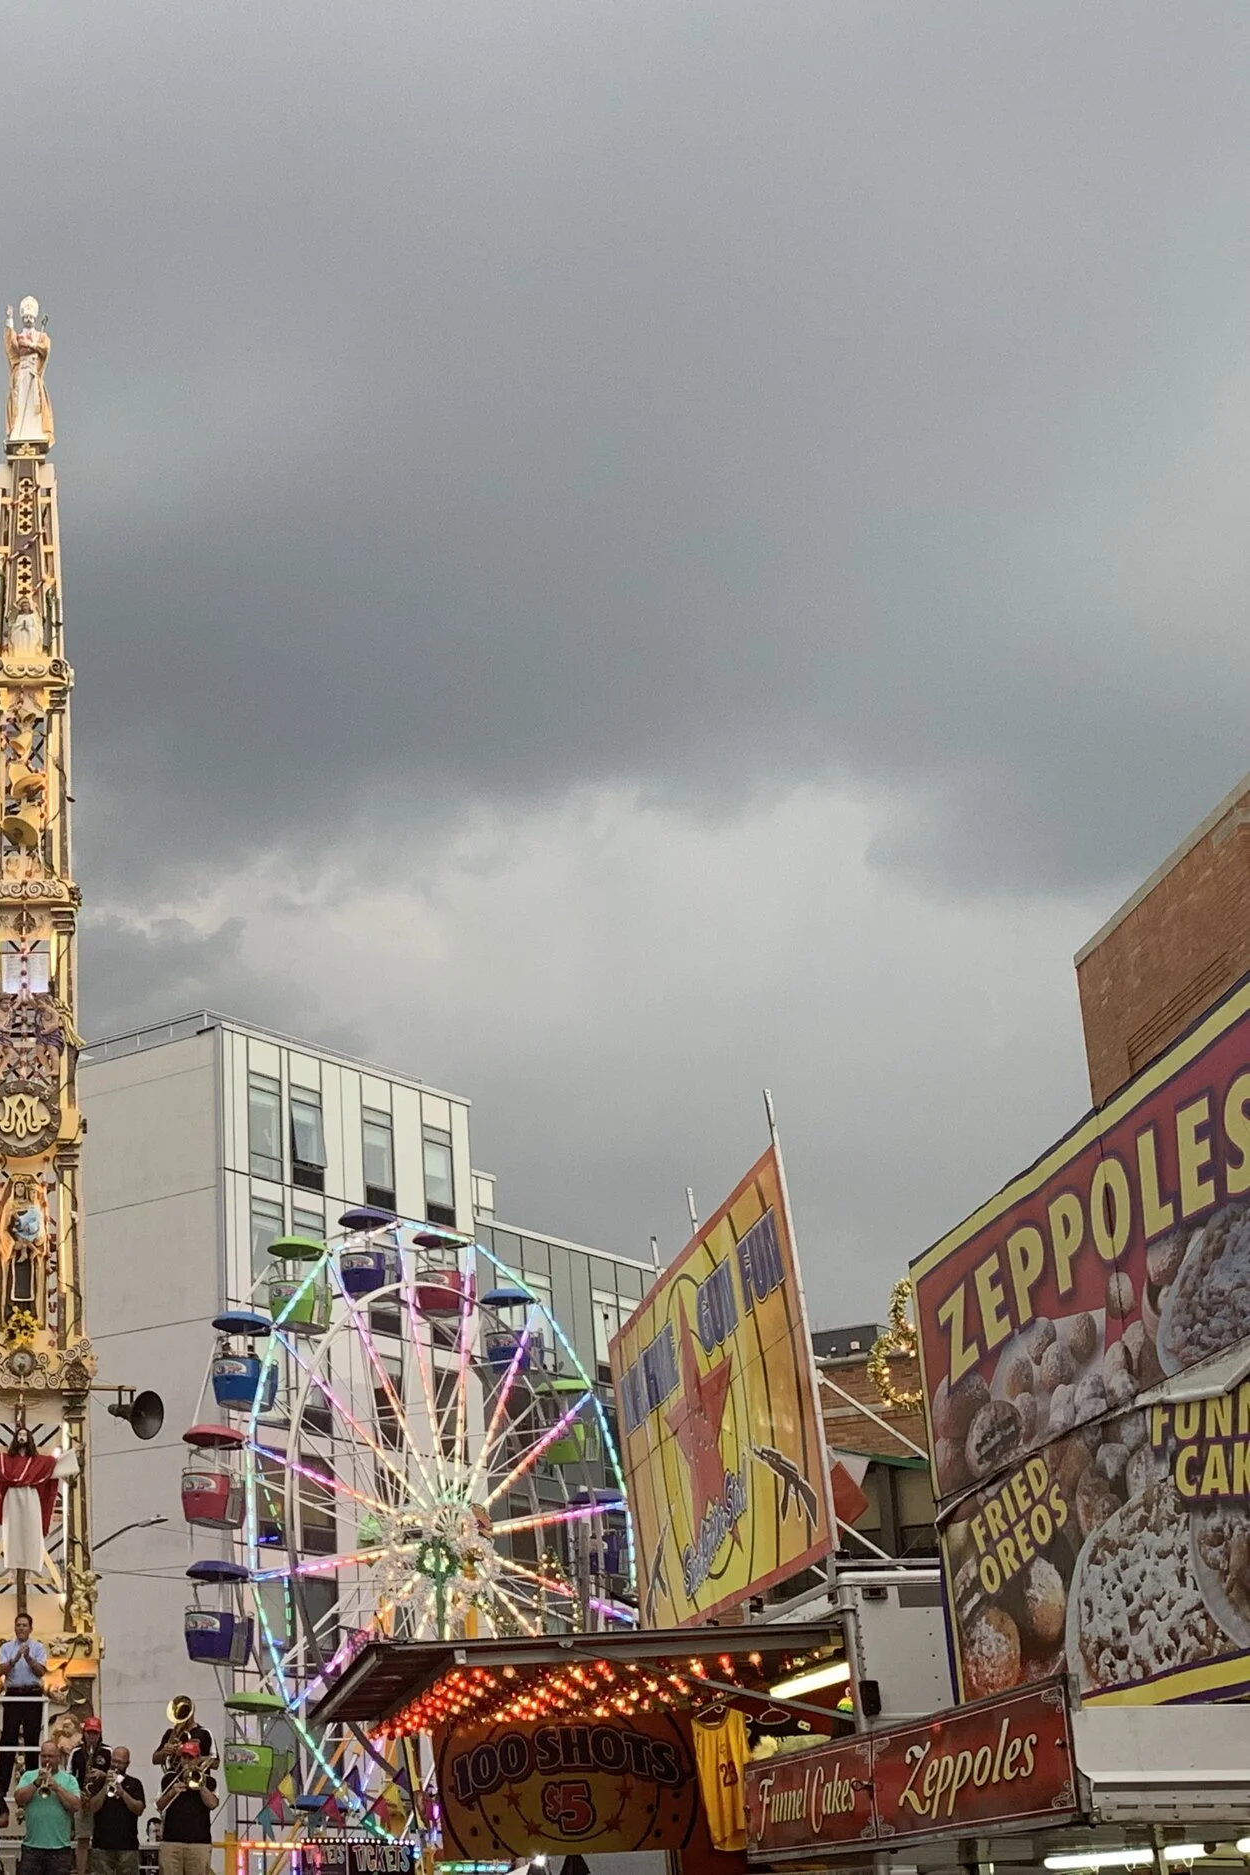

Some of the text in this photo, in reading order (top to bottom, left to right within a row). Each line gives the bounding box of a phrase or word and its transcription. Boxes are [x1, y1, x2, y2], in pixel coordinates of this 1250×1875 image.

[937, 1073, 1250, 1387] ZEPPOLES
[697, 1254, 739, 1357] GUN
[736, 1203, 787, 1318] FUN
[970, 1458, 1049, 1554] FRIED
[979, 1483, 1068, 1594] OREOS
[452, 1725, 681, 1801] 100 SHOTS
[719, 1761, 738, 1787] 23
[757, 1762, 856, 1841] Funnel Cakes
[898, 1717, 1038, 1820] Zeppoles
[545, 1782, 594, 1835] $5
[352, 1844, 411, 1873] TICKETS
